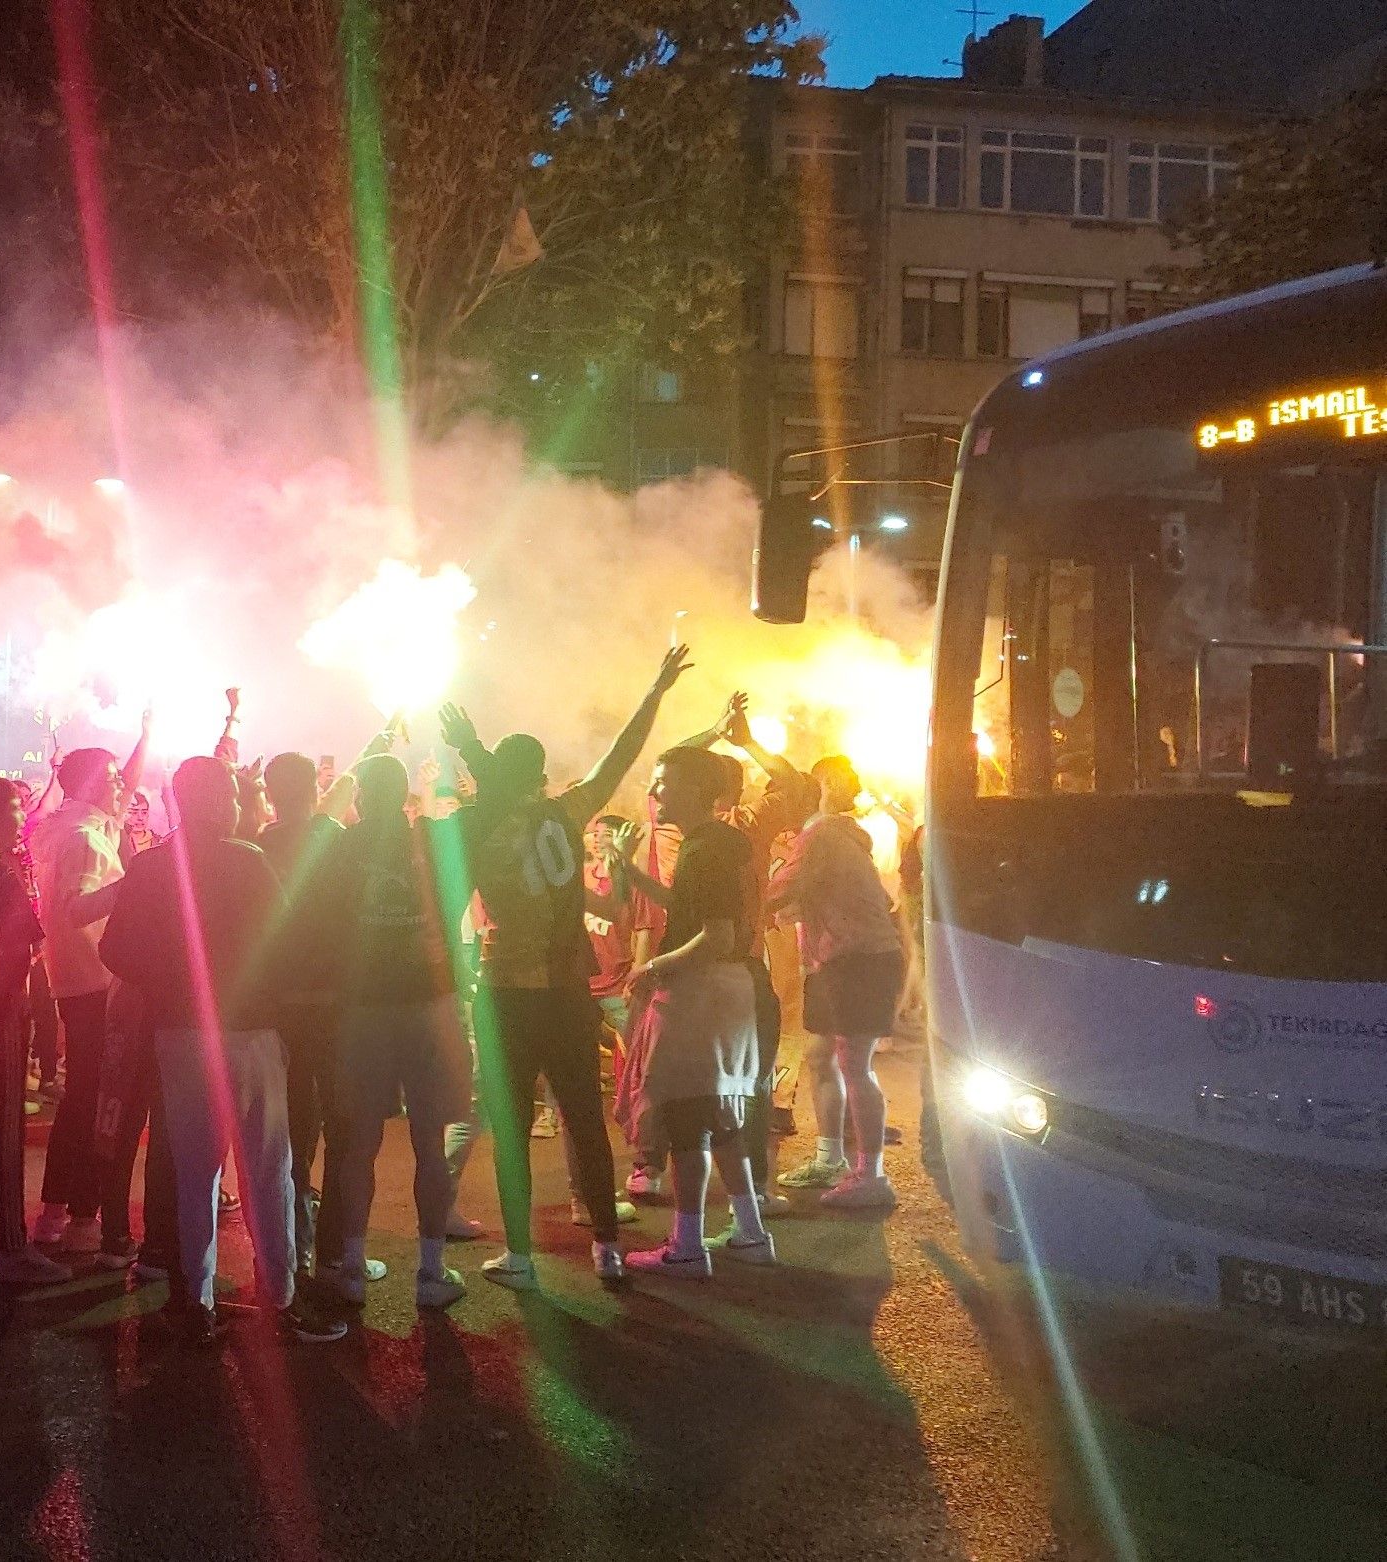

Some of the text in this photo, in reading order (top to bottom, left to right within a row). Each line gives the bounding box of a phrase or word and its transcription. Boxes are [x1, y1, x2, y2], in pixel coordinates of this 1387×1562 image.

[1198, 417, 1256, 448] 8-B
[1241, 1268, 1284, 1307] 59
[1300, 1281, 1367, 1325] AHS
